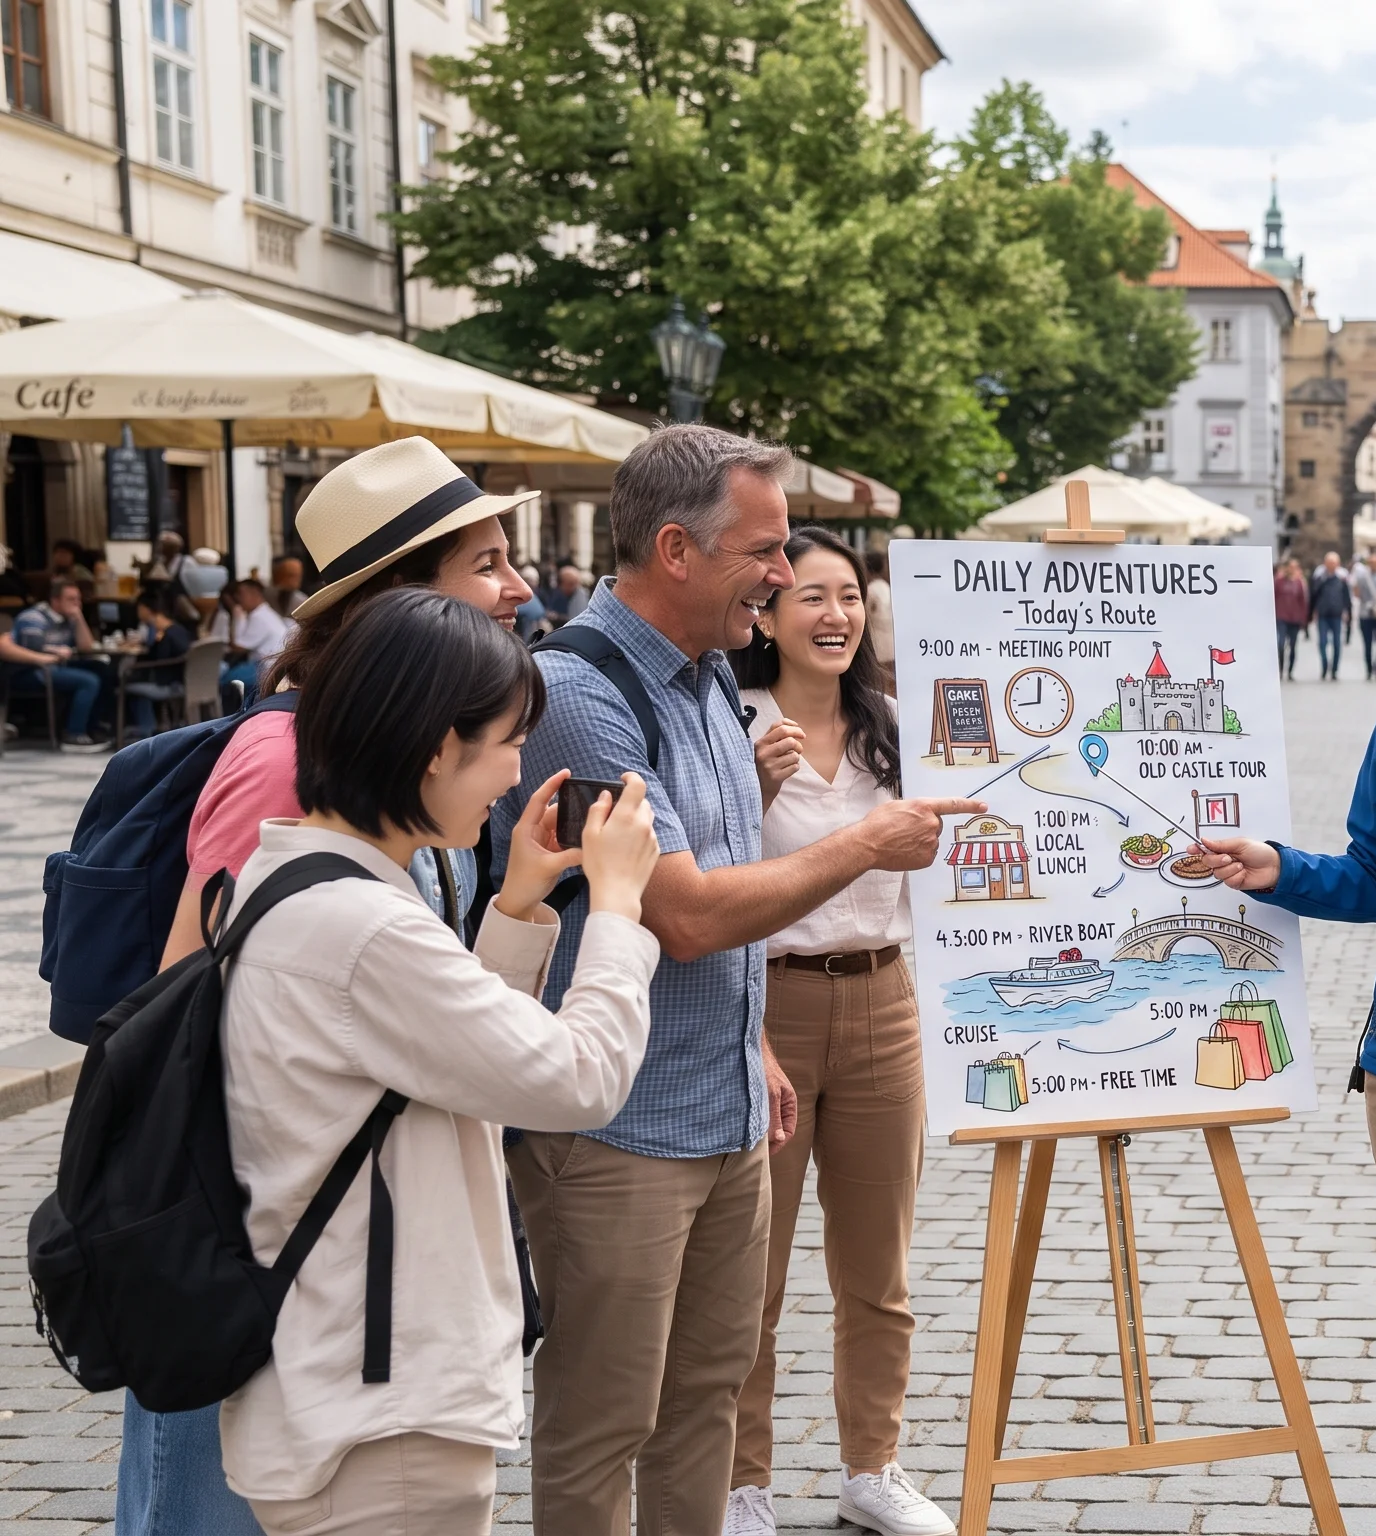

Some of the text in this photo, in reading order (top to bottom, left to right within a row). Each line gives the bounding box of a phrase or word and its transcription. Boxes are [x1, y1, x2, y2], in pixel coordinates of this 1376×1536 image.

[953, 558, 1218, 596] DAILY ADVENTURES
[1100, 600, 1157, 626] Route
[919, 638, 954, 658] 9:00
[959, 642, 980, 657] AM
[999, 639, 1063, 659] MEETING
[1069, 640, 1112, 658] POINT
[1136, 738, 1179, 756] 10:00
[1184, 741, 1203, 756] AM
[1139, 760, 1267, 779] OLD CASTLE TOUR
[1034, 810, 1091, 828] 1:00 PM
[1035, 833, 1085, 852] LOCAL
[1037, 856, 1087, 875] LUNCH
[936, 928, 988, 948] 4.3:00
[992, 931, 1012, 946] PM
[1028, 924, 1074, 944] RIVER
[1077, 922, 1116, 942] BOAT
[1150, 1001, 1184, 1021] 5:00
[1189, 1003, 1208, 1019] PM
[944, 1024, 999, 1045] CRUISE
[1031, 1074, 1066, 1095] 5:00
[1070, 1077, 1088, 1092] PM
[1100, 1070, 1137, 1090] FREE
[1140, 1067, 1178, 1088] TIME
